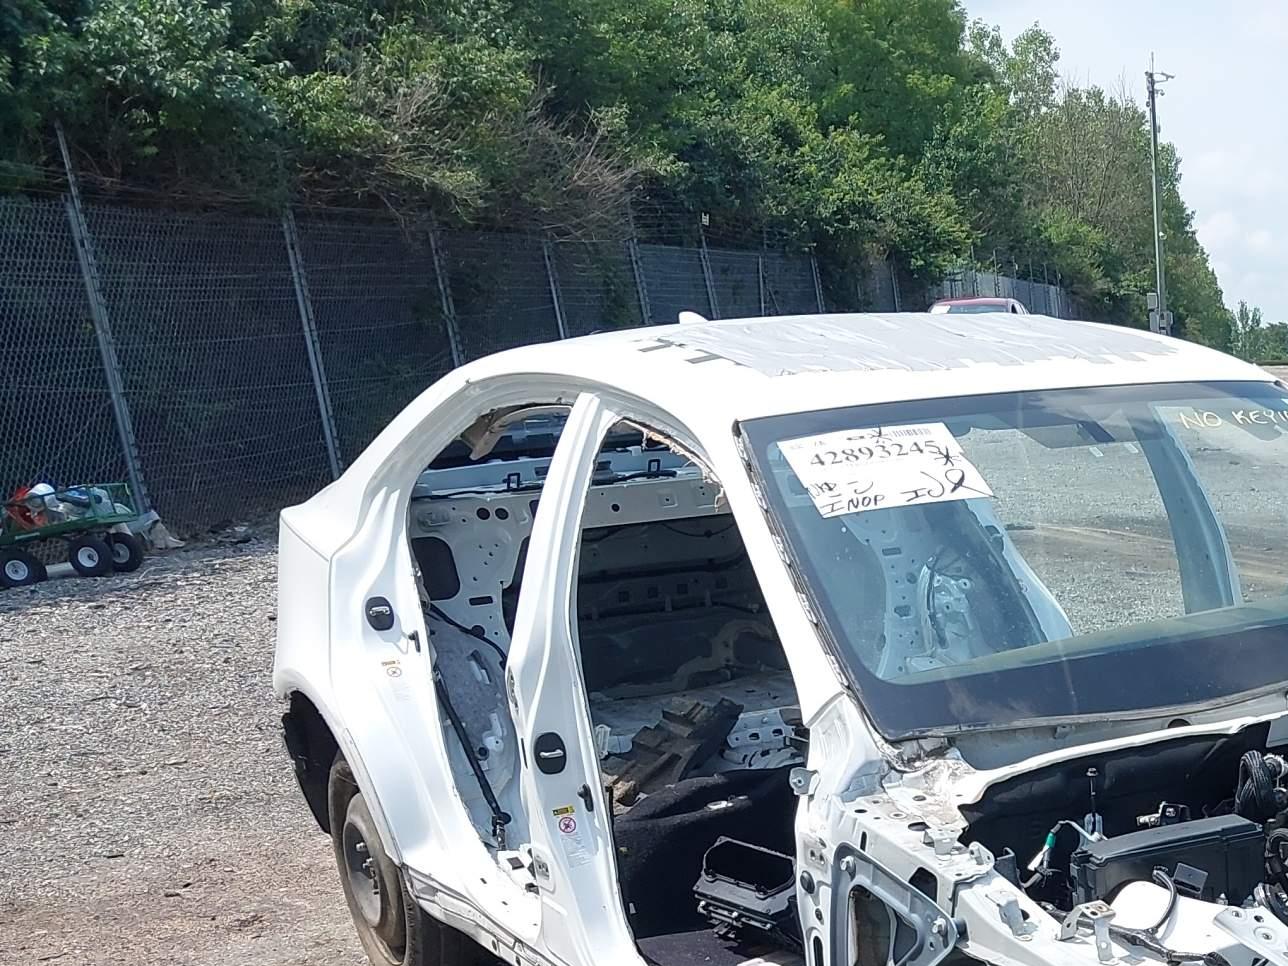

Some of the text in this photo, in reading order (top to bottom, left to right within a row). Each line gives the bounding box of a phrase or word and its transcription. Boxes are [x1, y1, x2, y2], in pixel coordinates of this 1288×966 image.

[1179, 411, 1222, 429] NO
[810, 440, 940, 466] 42893245
[819, 494, 885, 514] INOP
